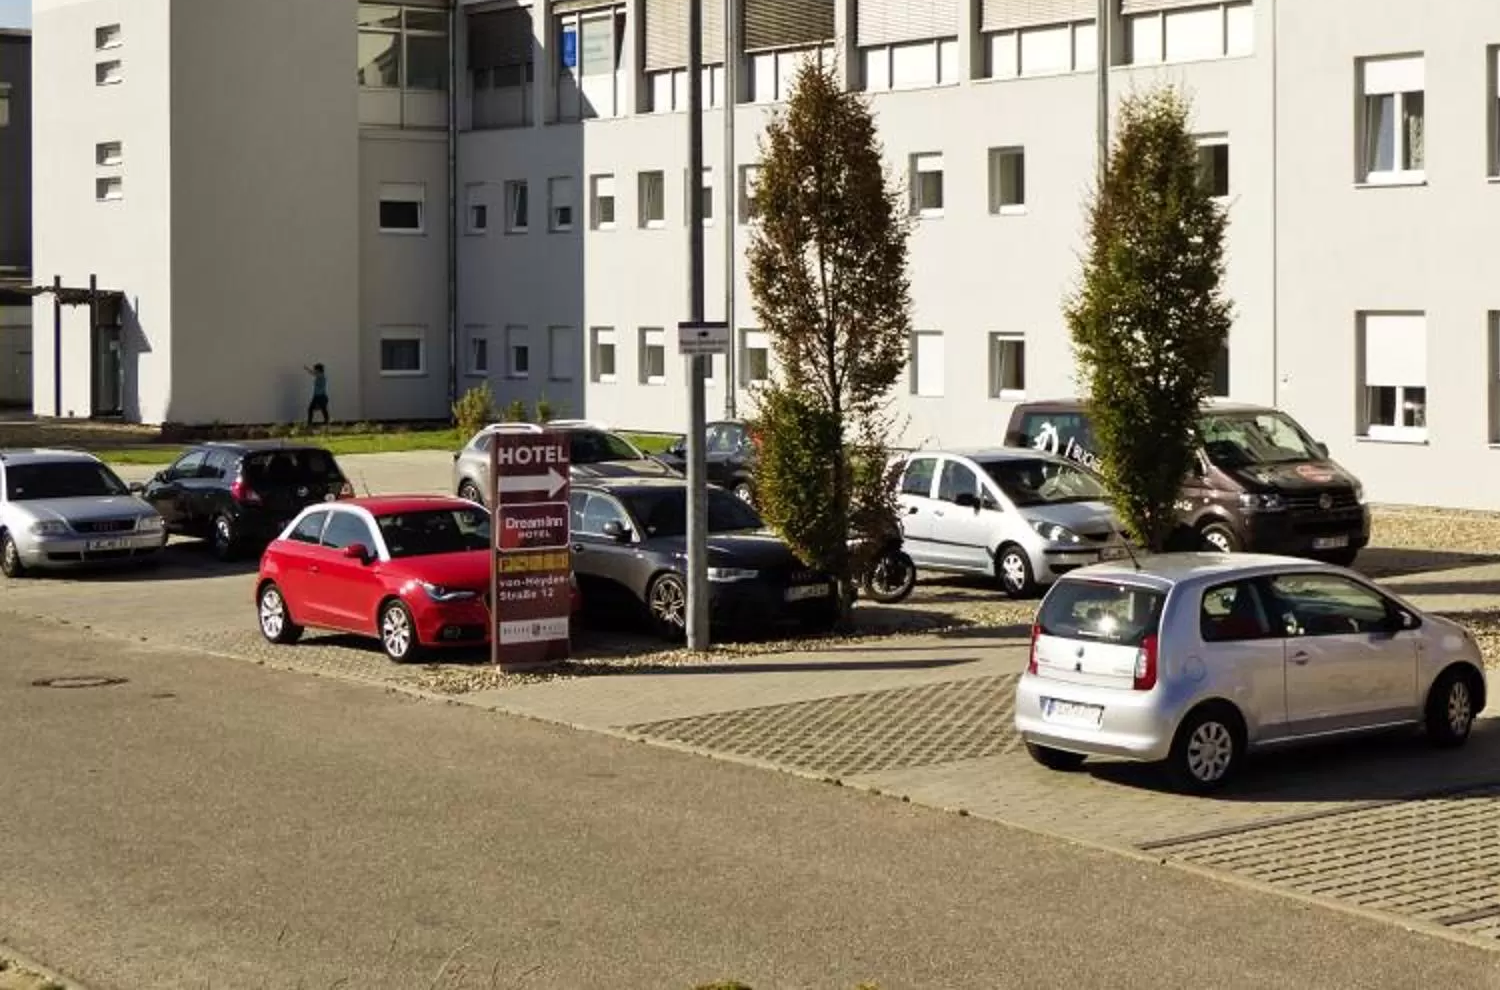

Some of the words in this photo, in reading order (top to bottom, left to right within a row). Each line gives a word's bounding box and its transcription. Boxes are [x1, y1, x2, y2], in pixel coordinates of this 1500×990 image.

[498, 445, 569, 465] HOTEL
[505, 517, 545, 529] Dream
[546, 515, 563, 527] Inn
[517, 529, 551, 539] HOTEL
